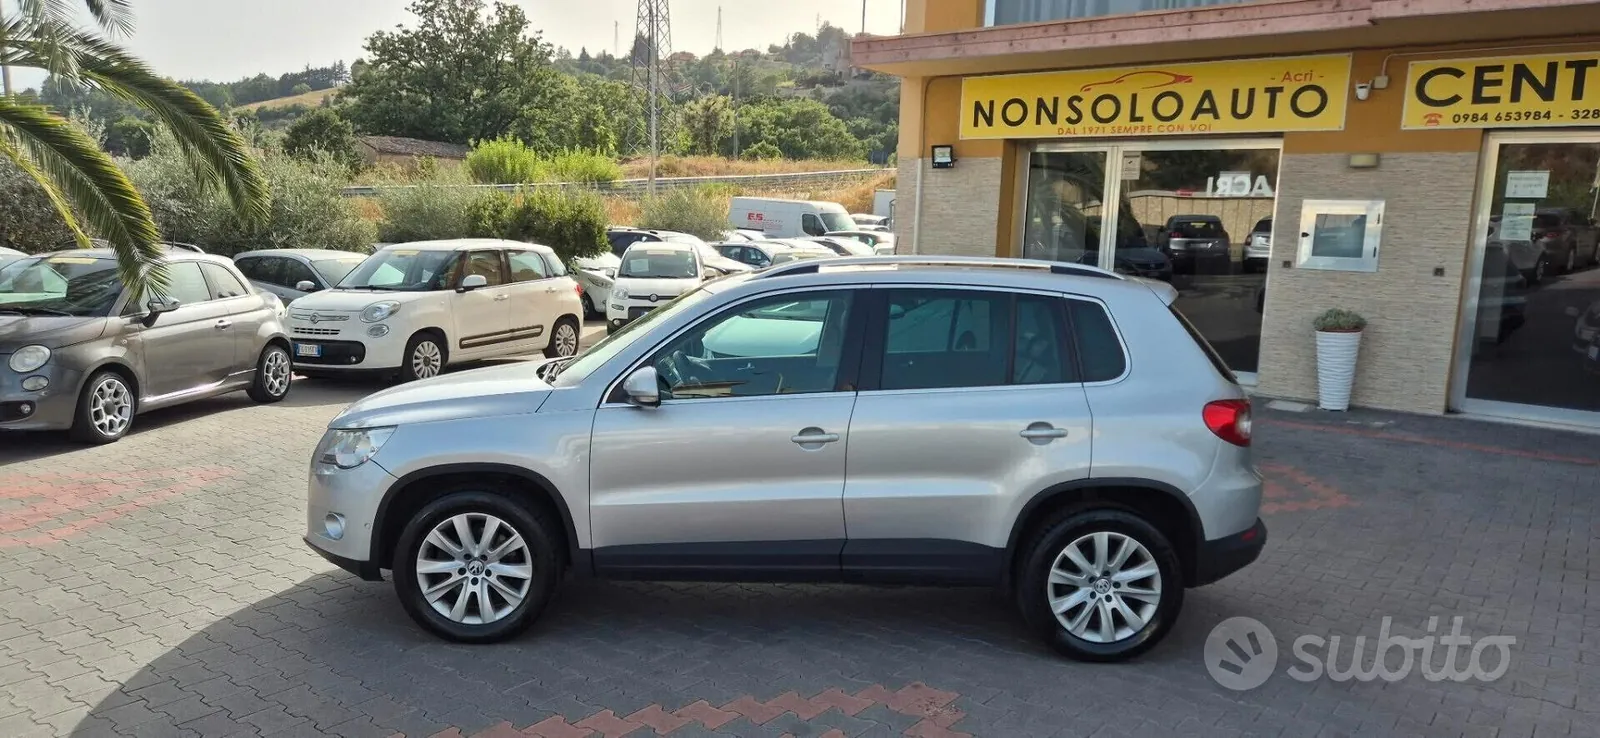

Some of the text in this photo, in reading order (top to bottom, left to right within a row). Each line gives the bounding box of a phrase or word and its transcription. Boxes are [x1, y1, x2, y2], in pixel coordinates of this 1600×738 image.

[1281, 70, 1314, 83] Acri
[1415, 59, 1598, 107] CENT
[973, 84, 1329, 128] NONSOLOAUTO
[1452, 112, 1488, 124] 0984
[1494, 110, 1552, 122] 653984
[1571, 109, 1600, 120] 328
[1057, 123, 1213, 136] DAL 1971 SEMPRE CON VOI
